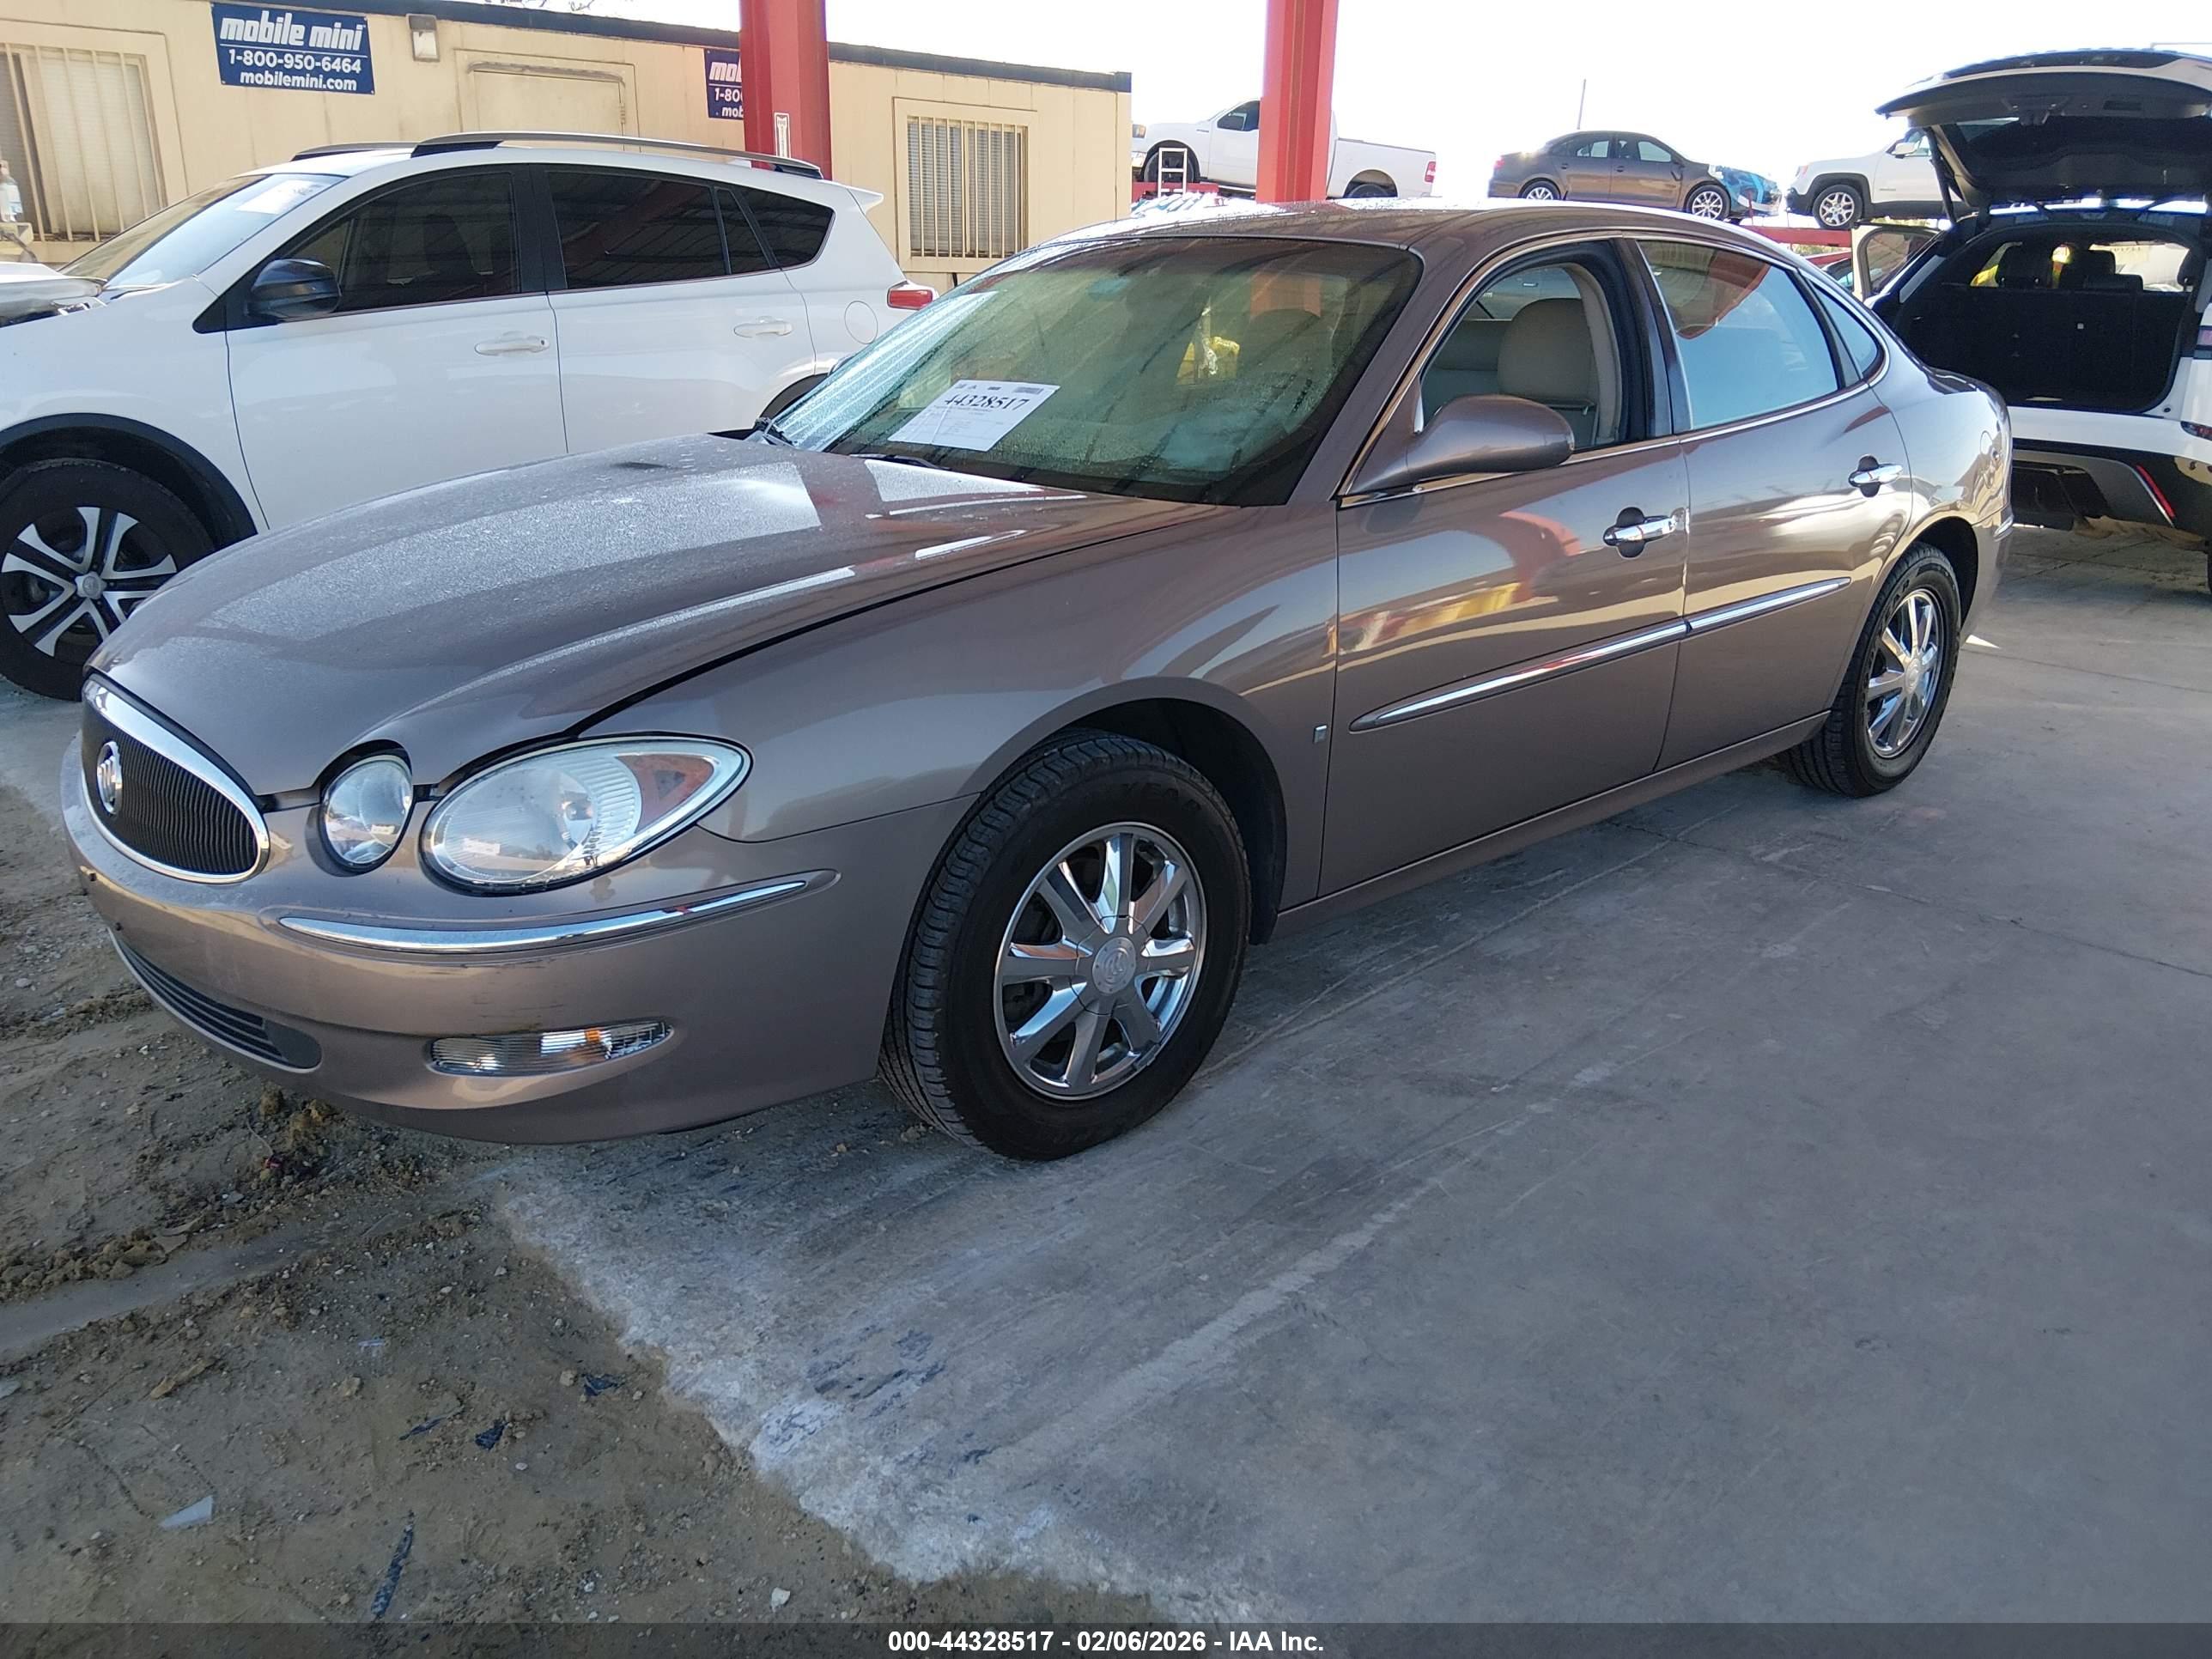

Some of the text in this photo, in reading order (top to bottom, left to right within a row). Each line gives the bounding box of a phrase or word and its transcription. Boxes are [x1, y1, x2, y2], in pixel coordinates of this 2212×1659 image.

[220, 10, 363, 51] mobile mini
[228, 49, 362, 74] 1-800-950-6464
[240, 70, 357, 91] mobilemini.com
[944, 393, 1030, 410] 44328517
